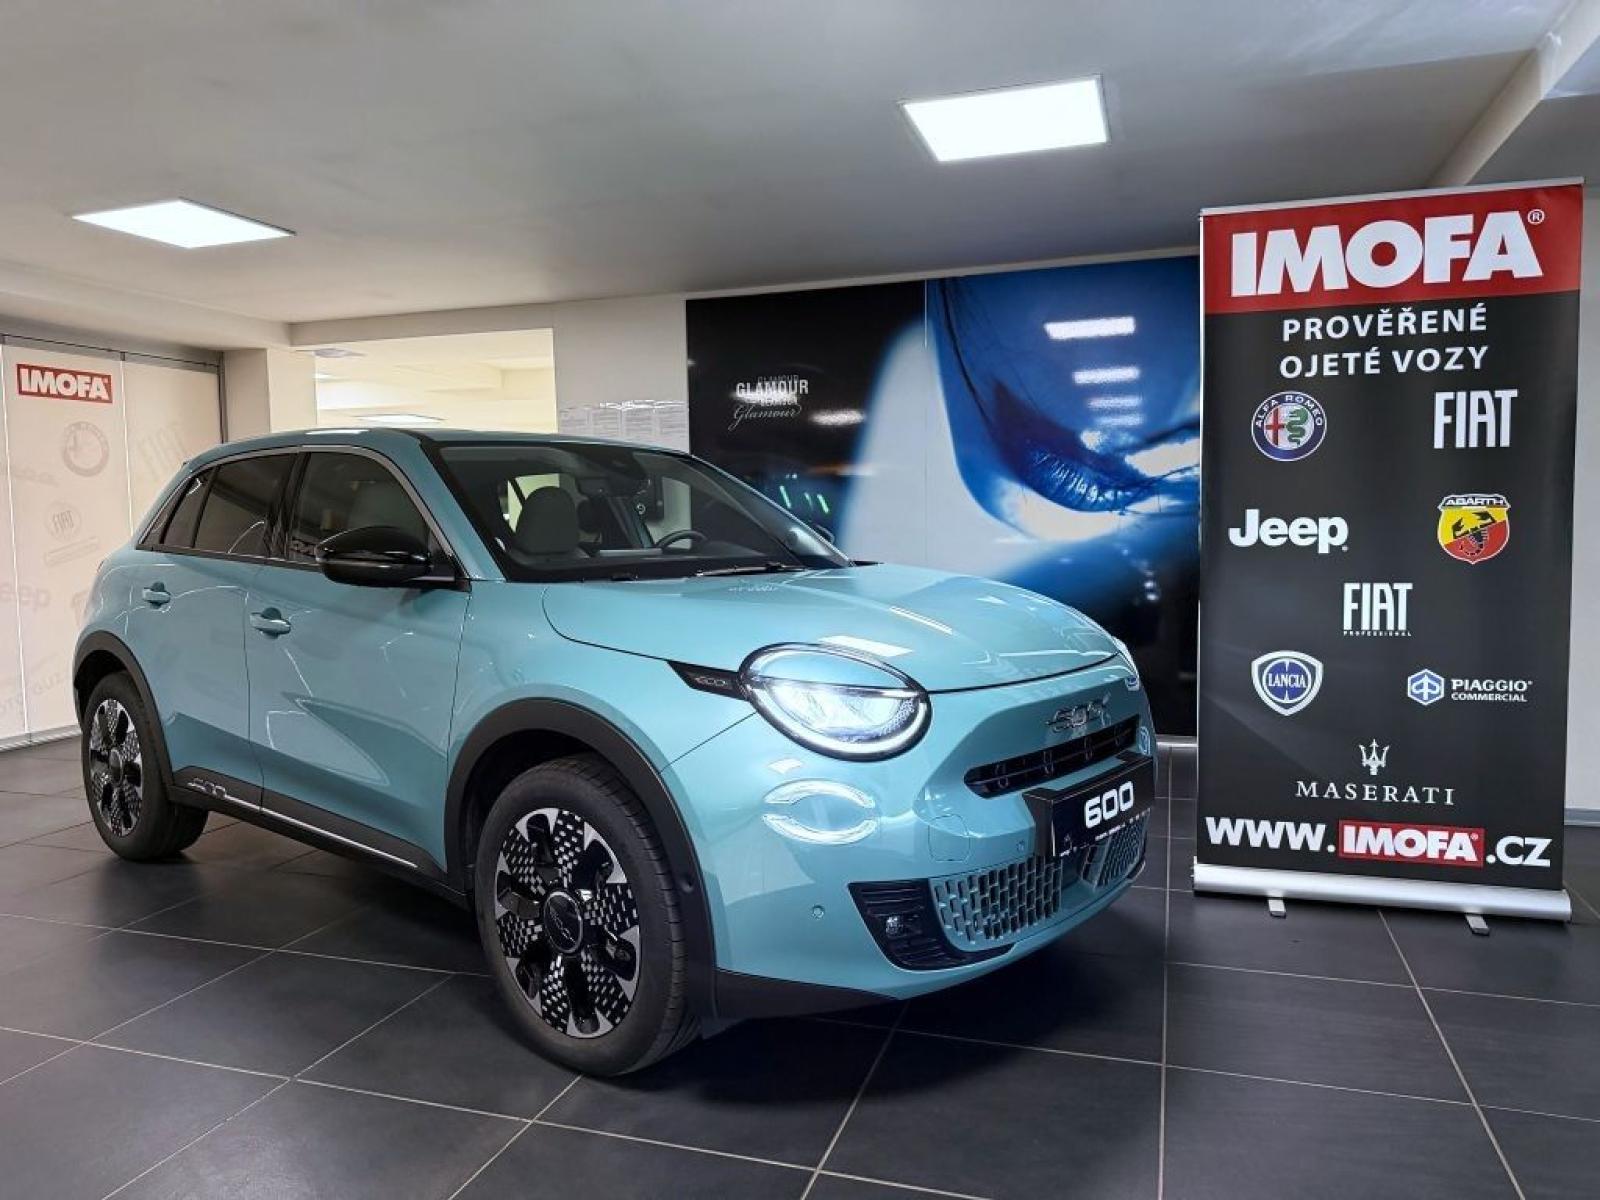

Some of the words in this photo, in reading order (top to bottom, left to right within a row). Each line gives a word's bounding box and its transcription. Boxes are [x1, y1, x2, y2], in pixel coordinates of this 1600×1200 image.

[1282, 302, 1487, 342] PROVĚŘENÉ
[1279, 347, 1381, 379] OJETÉ
[1391, 345, 1489, 373] VOZY
[19, 368, 109, 401] IMOFA
[735, 379, 809, 398] GLAMOUR
[1255, 399, 1279, 427] ALFA
[1285, 395, 1323, 426] ROMEO
[1433, 389, 1518, 449] FIAT
[1445, 497, 1505, 506] ABARTH
[1228, 508, 1349, 554] Jeep
[1343, 582, 1413, 631] FIAT
[1268, 672, 1307, 688] LANCIA
[1451, 679, 1528, 692] PIAGGIO
[1451, 692, 1528, 702] COMMERCIAL
[1084, 780, 1134, 829] 600
[1295, 780, 1455, 805] MASERATI
